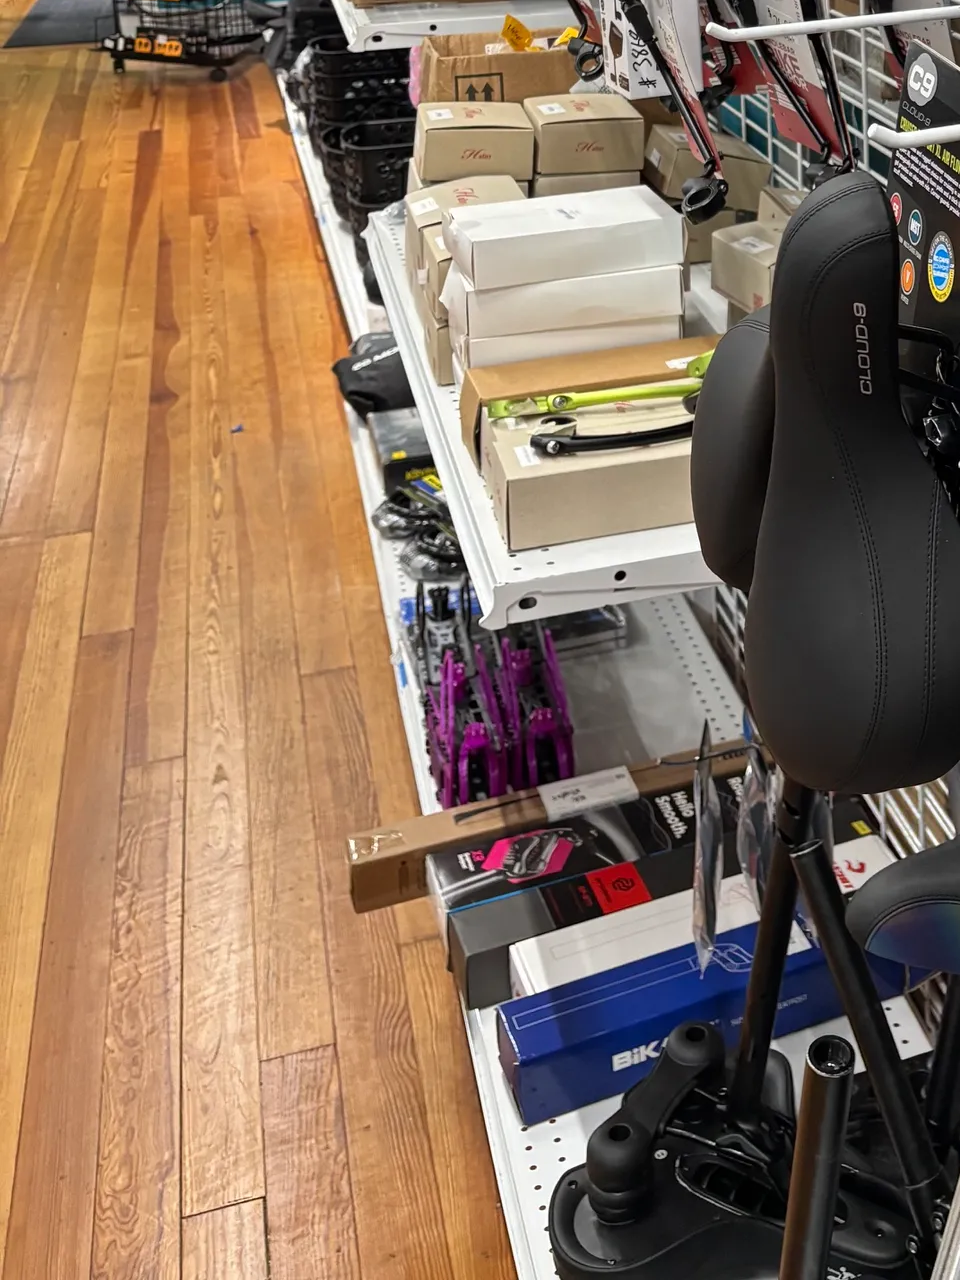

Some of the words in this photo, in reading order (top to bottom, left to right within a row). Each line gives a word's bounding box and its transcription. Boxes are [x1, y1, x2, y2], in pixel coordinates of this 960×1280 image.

[909, 64, 935, 99] C9
[902, 101, 931, 126] CLOUD-9
[853, 302, 872, 395] CLOUD-9
[655, 795, 690, 840] Smooth.
[670, 790, 695, 818] Hello
